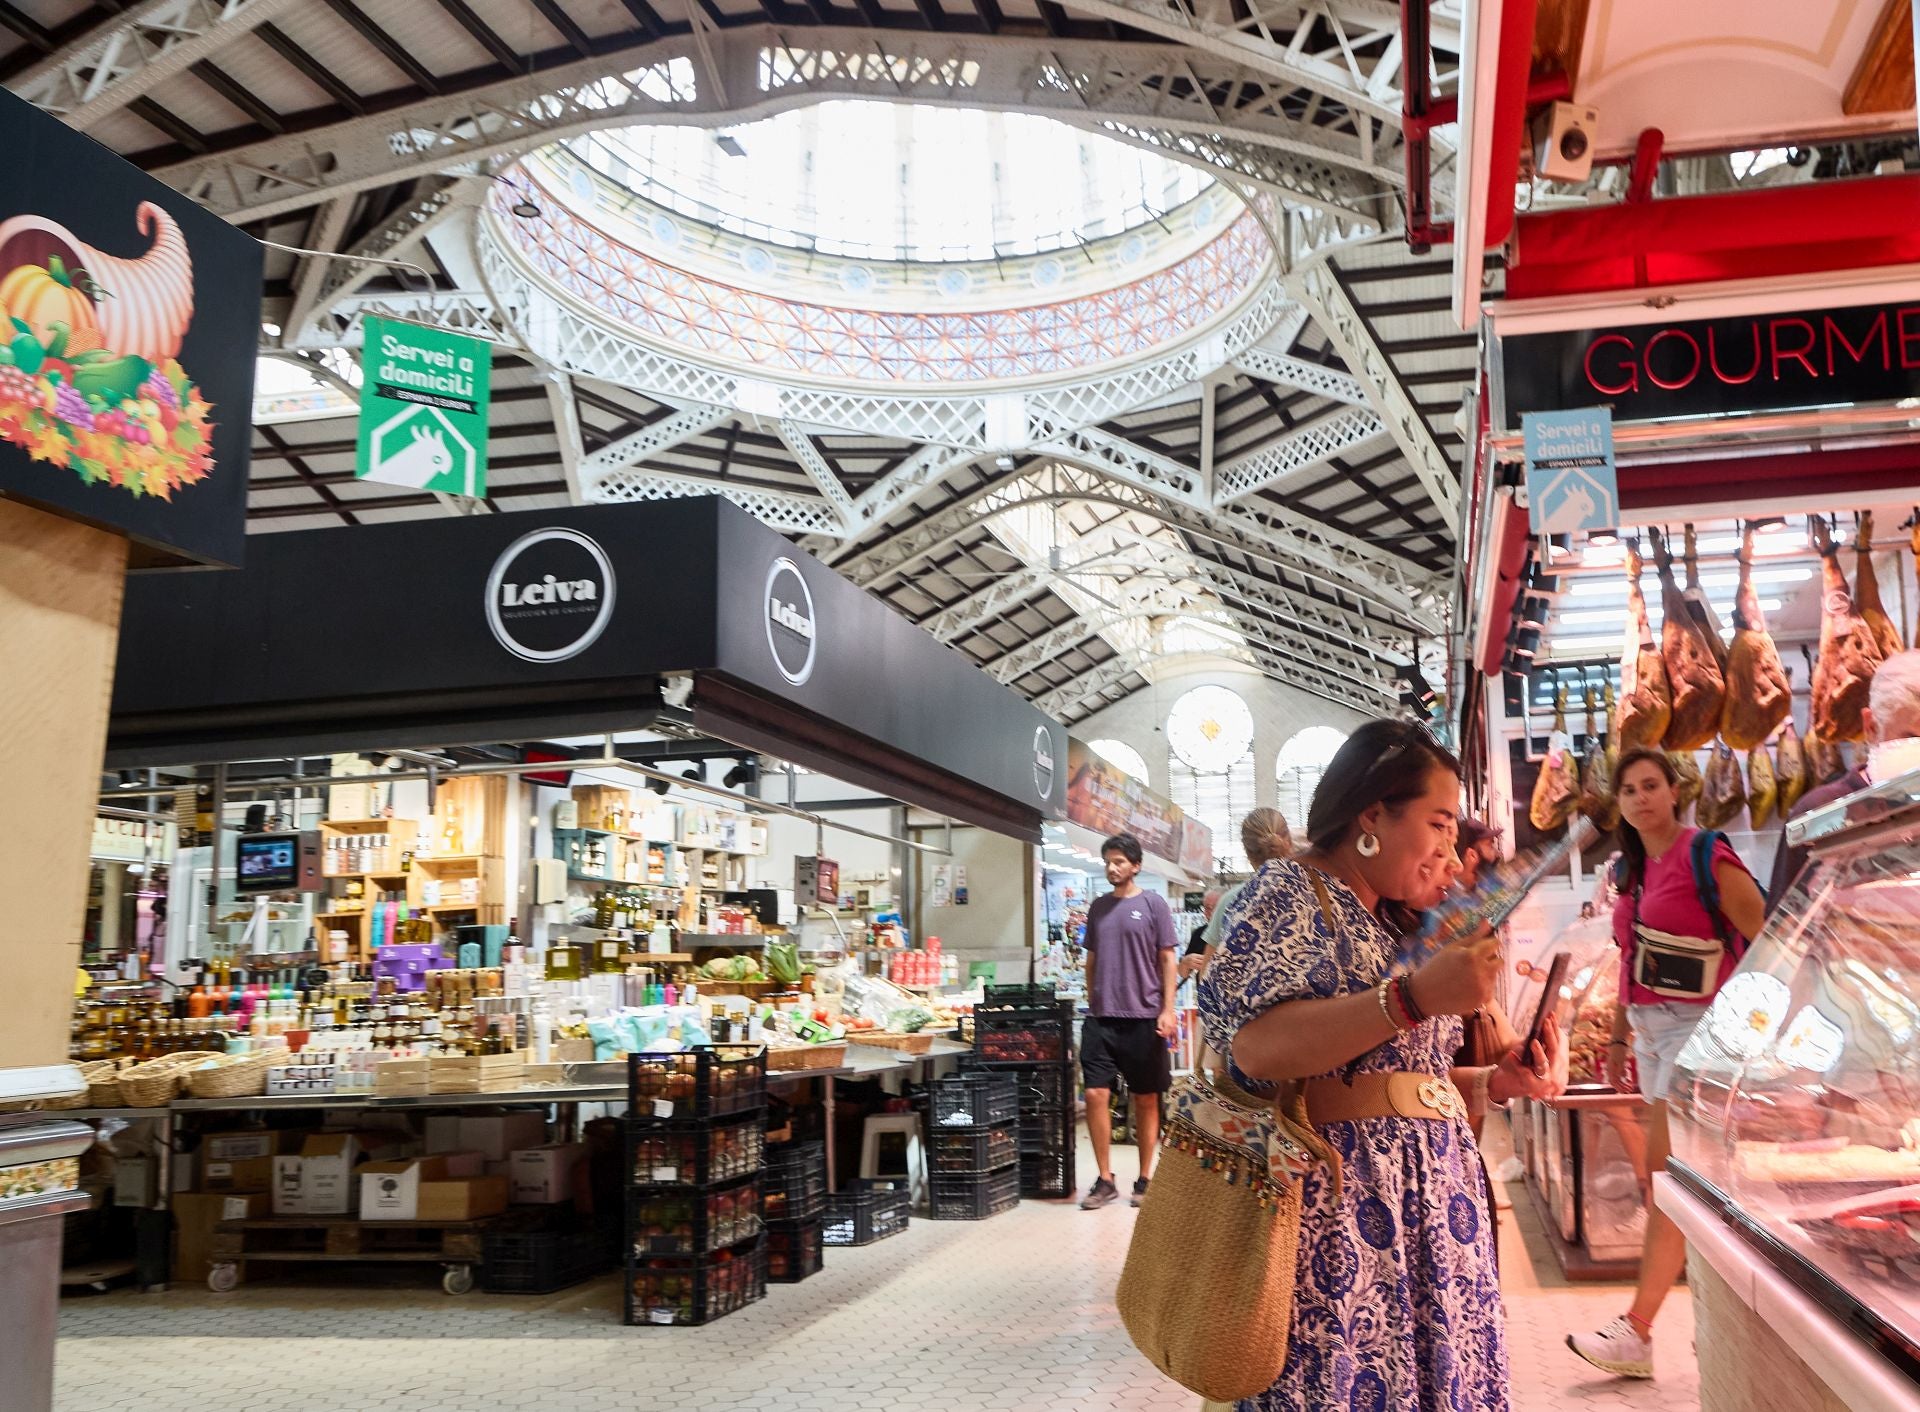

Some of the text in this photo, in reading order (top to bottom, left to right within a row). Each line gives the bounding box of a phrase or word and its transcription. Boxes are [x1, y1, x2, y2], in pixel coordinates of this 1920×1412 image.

[381, 334, 473, 373] Servei a
[378, 360, 473, 397] domicili
[1535, 420, 1588, 440] Servei
[1537, 436, 1603, 457] domicili
[502, 574, 597, 607] Leiva
